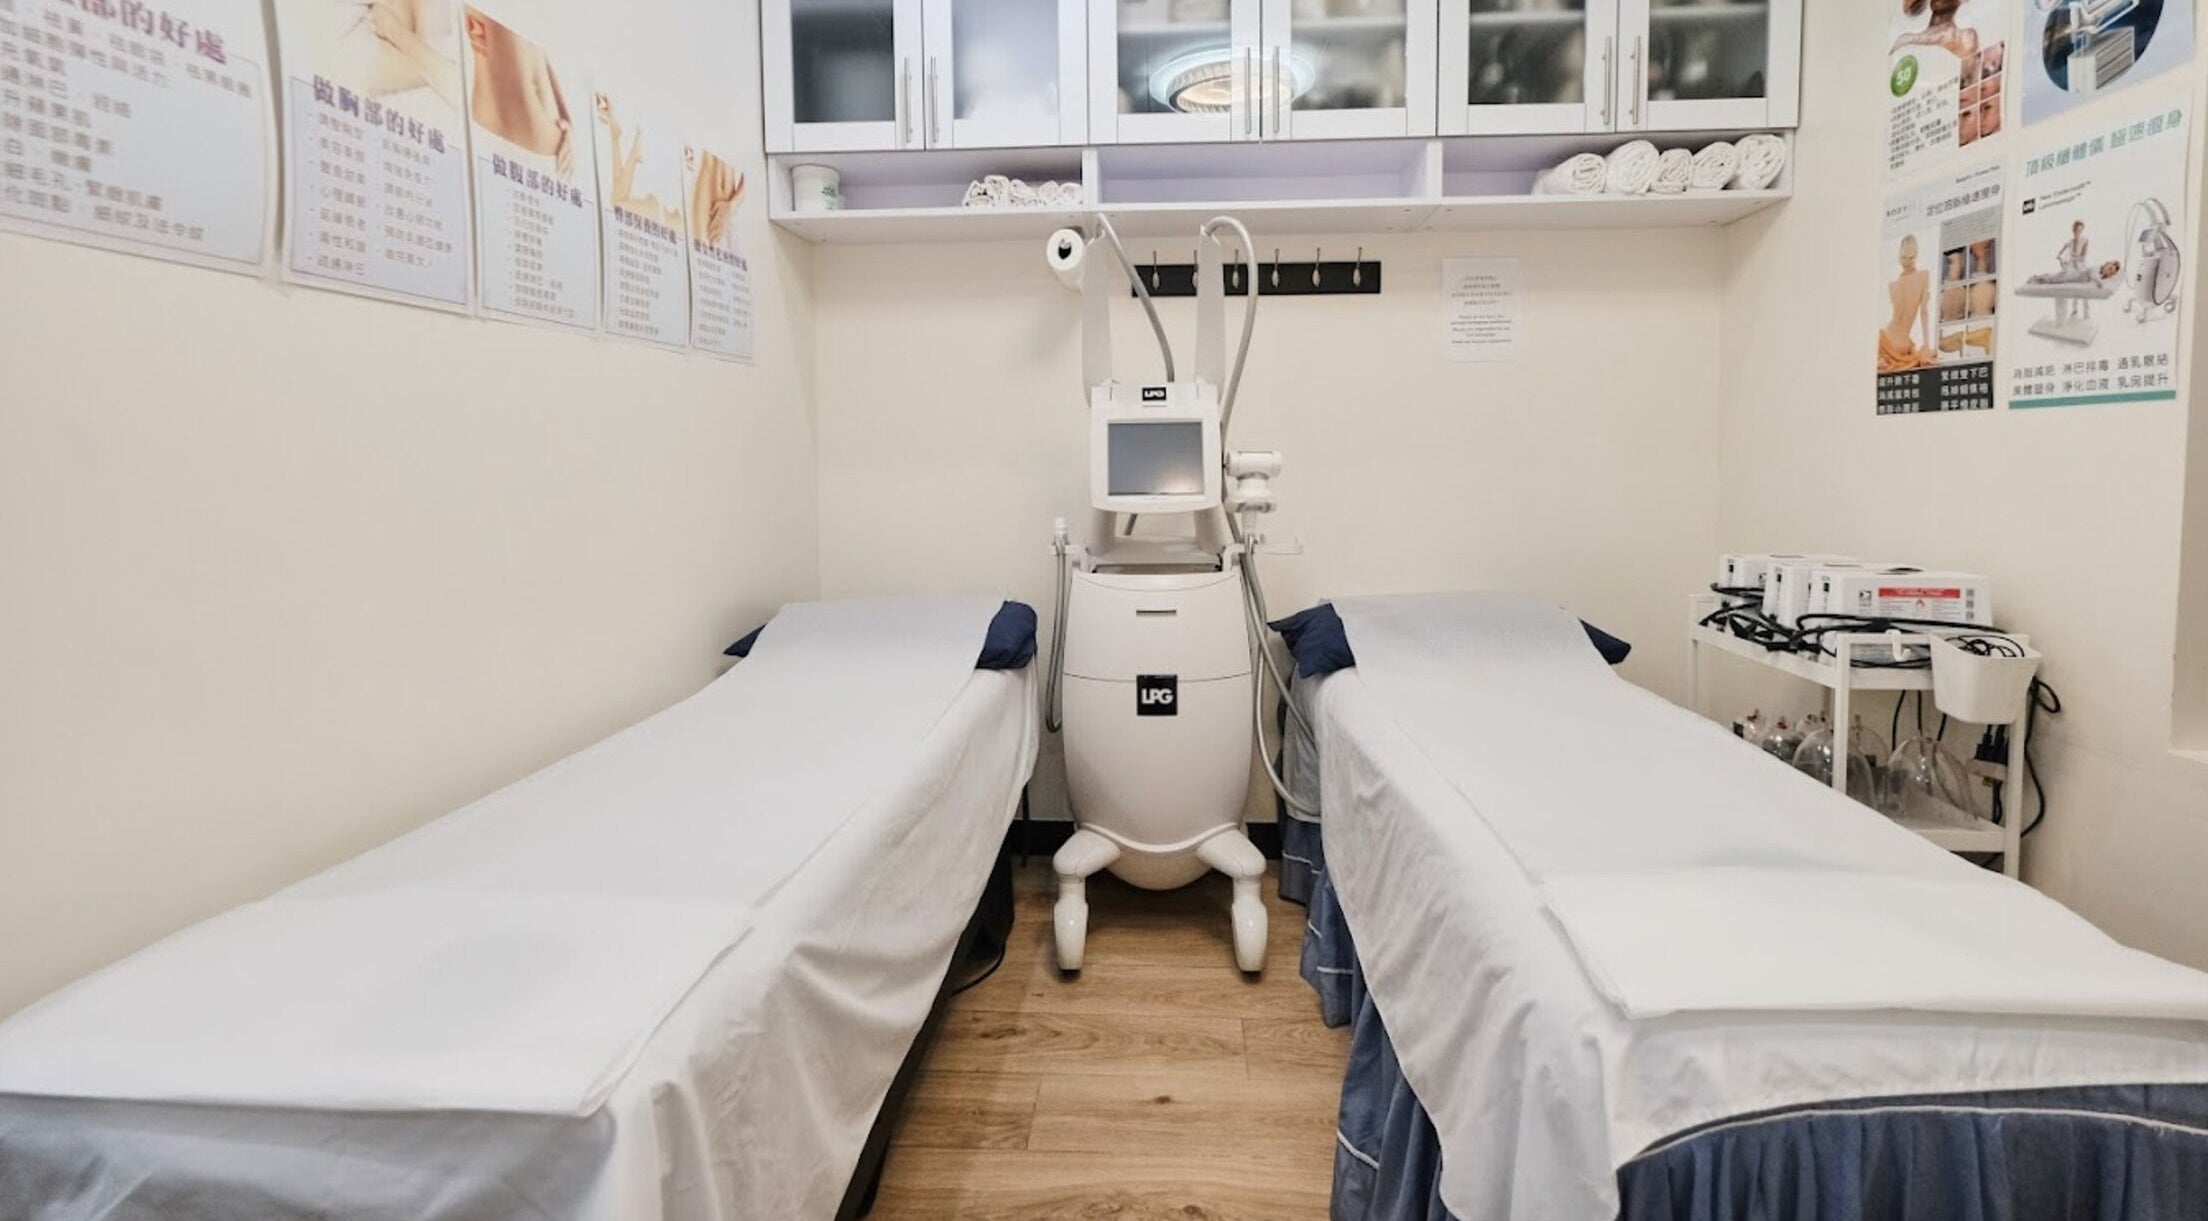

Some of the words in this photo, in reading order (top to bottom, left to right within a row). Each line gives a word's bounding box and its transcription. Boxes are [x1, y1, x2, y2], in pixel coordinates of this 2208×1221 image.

[314, 74, 445, 153] 做胸部的好處
[493, 153, 582, 208] 做腹部的好處
[2063, 360, 2109, 375] 淋巴排毒
[2118, 373, 2169, 388] 乳房提升
[1141, 688, 1173, 704] LPG
